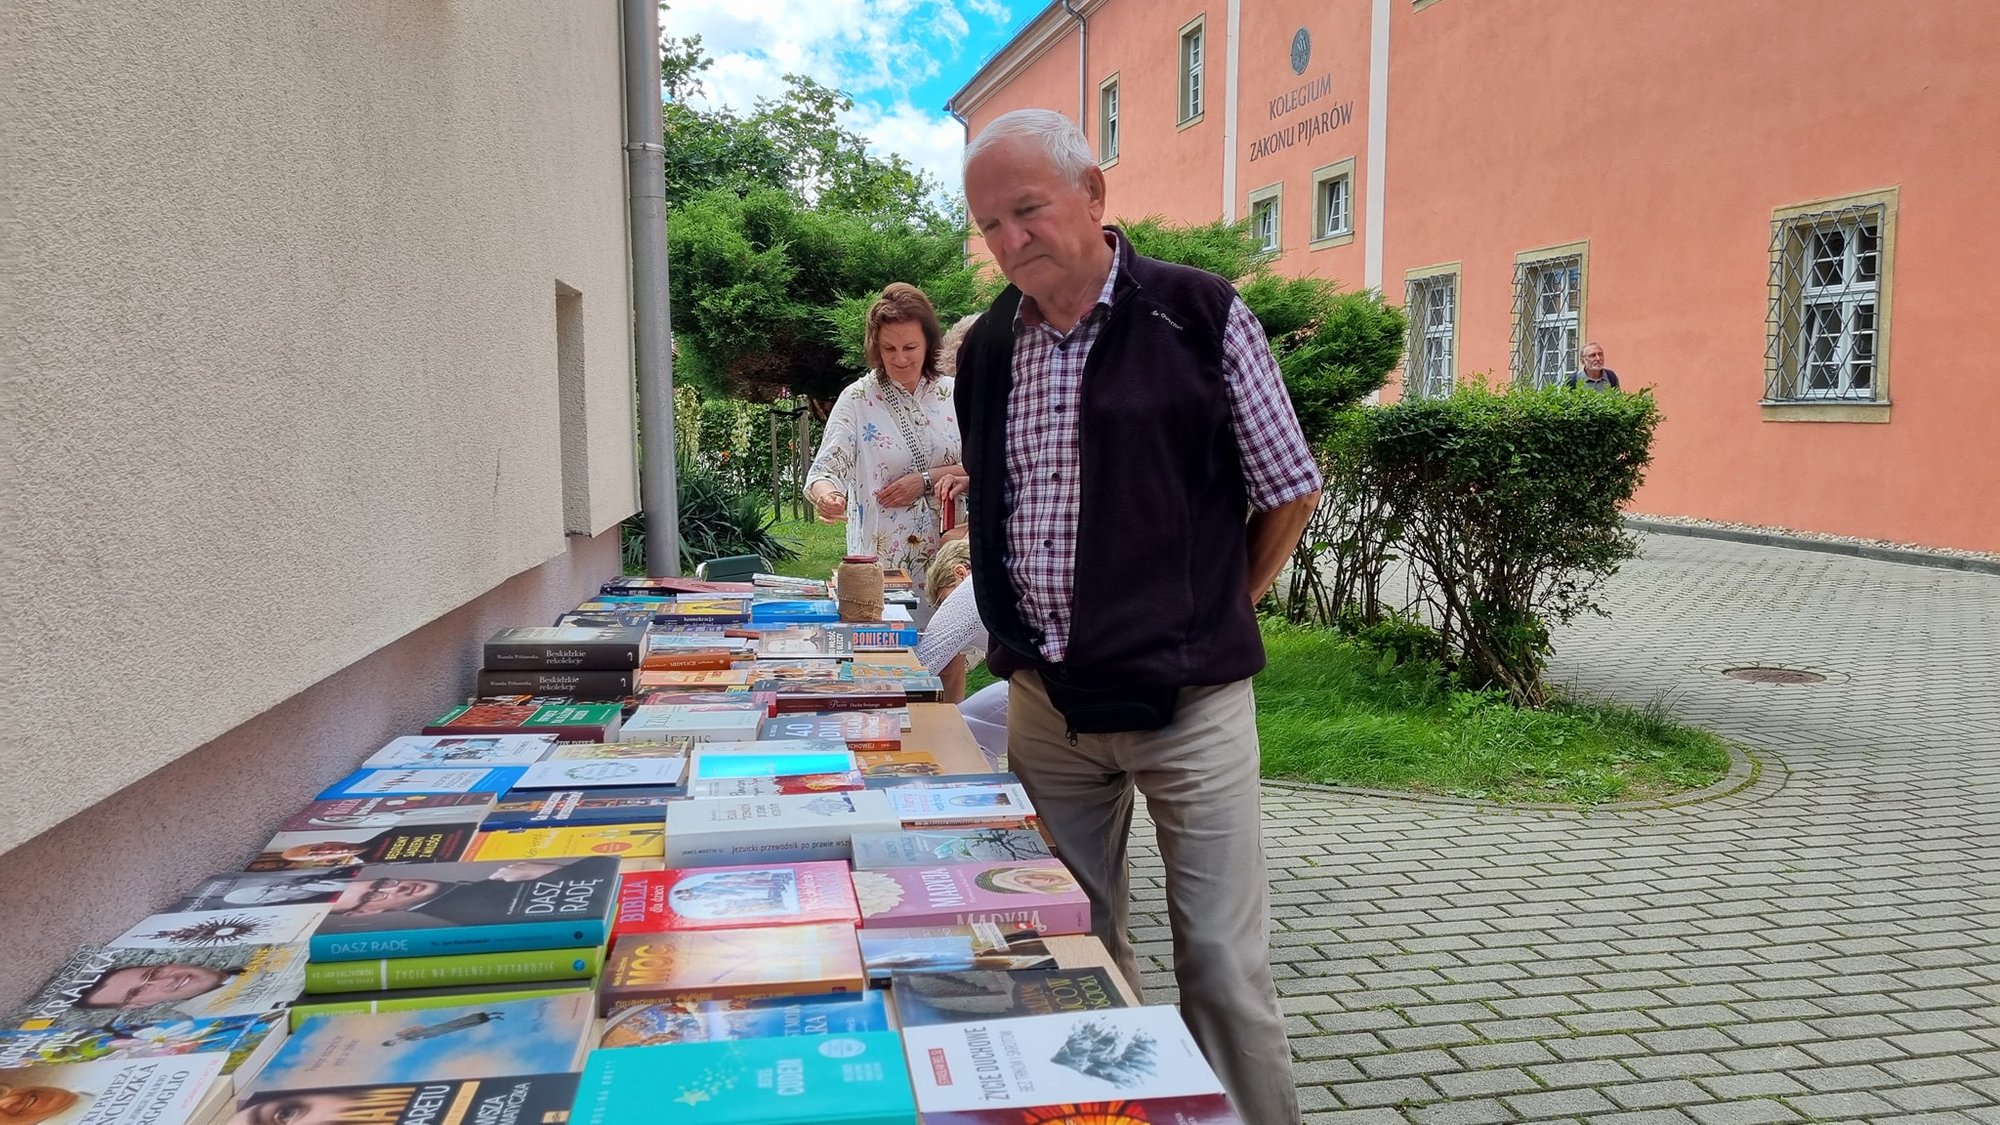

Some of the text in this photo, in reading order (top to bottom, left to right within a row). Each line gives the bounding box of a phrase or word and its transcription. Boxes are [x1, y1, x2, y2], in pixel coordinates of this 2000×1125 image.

[1269, 73, 1332, 120] KOLEGIUM
[1250, 100, 1354, 162] ZAKONU PIJARÓW
[546, 649, 587, 657] Beskidzkie
[853, 632, 899, 646] BONIECKI
[546, 657, 584, 665] rekolekcje
[540, 676, 580, 684] Beskidzkie
[540, 683, 576, 691] rekolekcje
[785, 718, 814, 738] 40
[732, 844, 759, 855] Jezuicki
[760, 842, 799, 853] przewodnik
[801, 842, 811, 850] po
[812, 839, 834, 848] prawie
[525, 879, 564, 915] DASZ
[559, 878, 604, 913] RADĘ
[620, 880, 648, 923] BIBLIA
[649, 884, 664, 914] dla dzieci
[920, 867, 966, 908] MARYJA
[331, 939, 409, 955] DASZ RADĘ
[432, 968, 445, 978] NA
[451, 966, 492, 978] PEŁNEJ
[497, 961, 555, 975] PETARDZIE
[626, 945, 674, 986] MOC
[32, 948, 124, 1019] KRALKA
[777, 1057, 804, 1096] CUDEM
[964, 1026, 1010, 1101] ŻYCIE DUCHOWE
[98, 1064, 137, 1108] PAPIEŻA
